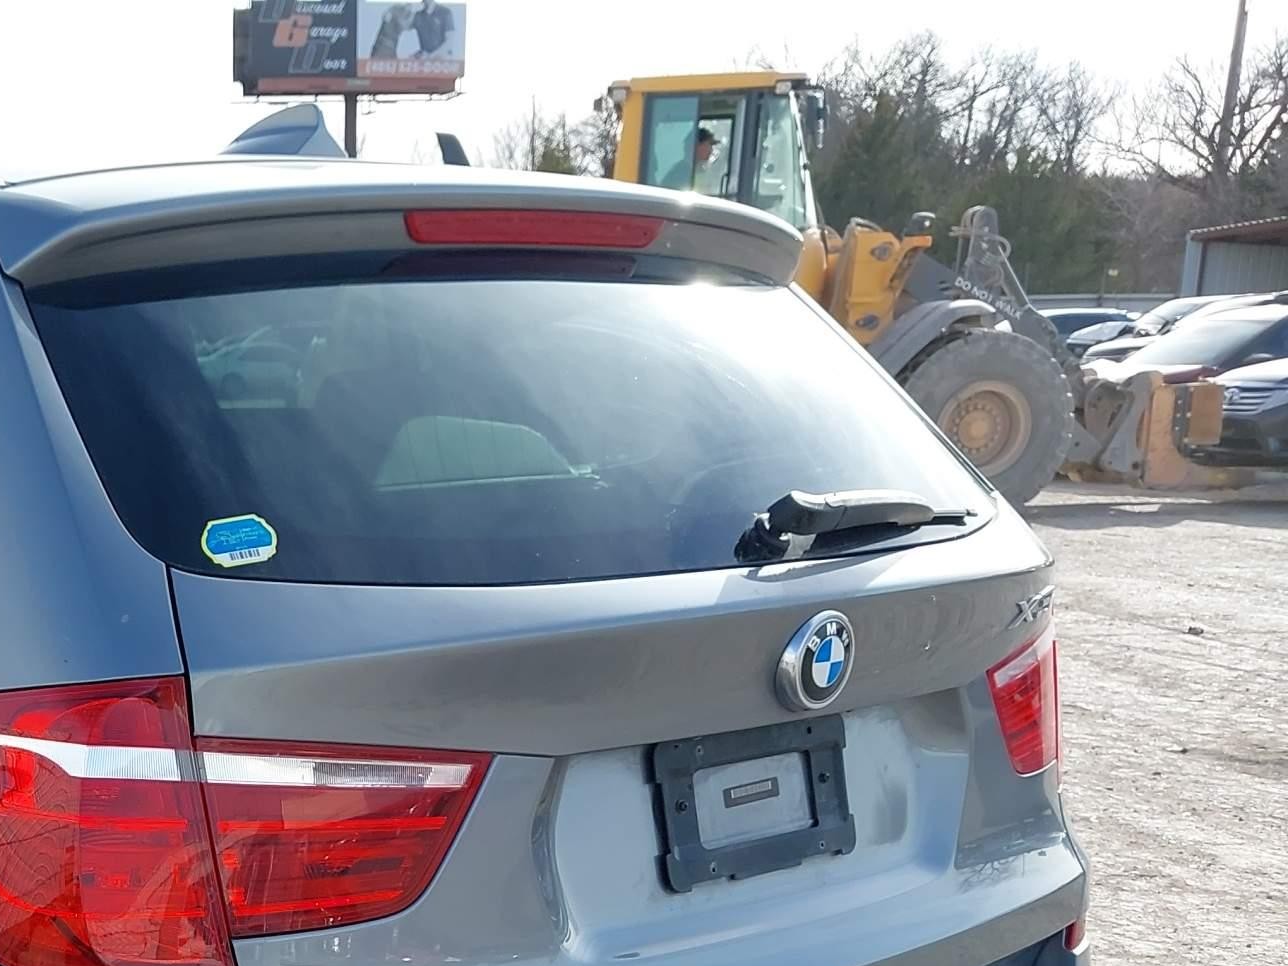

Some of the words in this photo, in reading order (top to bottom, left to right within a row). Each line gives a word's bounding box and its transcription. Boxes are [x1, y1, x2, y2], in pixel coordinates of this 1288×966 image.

[954, 276, 972, 291] DO
[994, 300, 1023, 320] WALK
[807, 621, 849, 652] BMW
